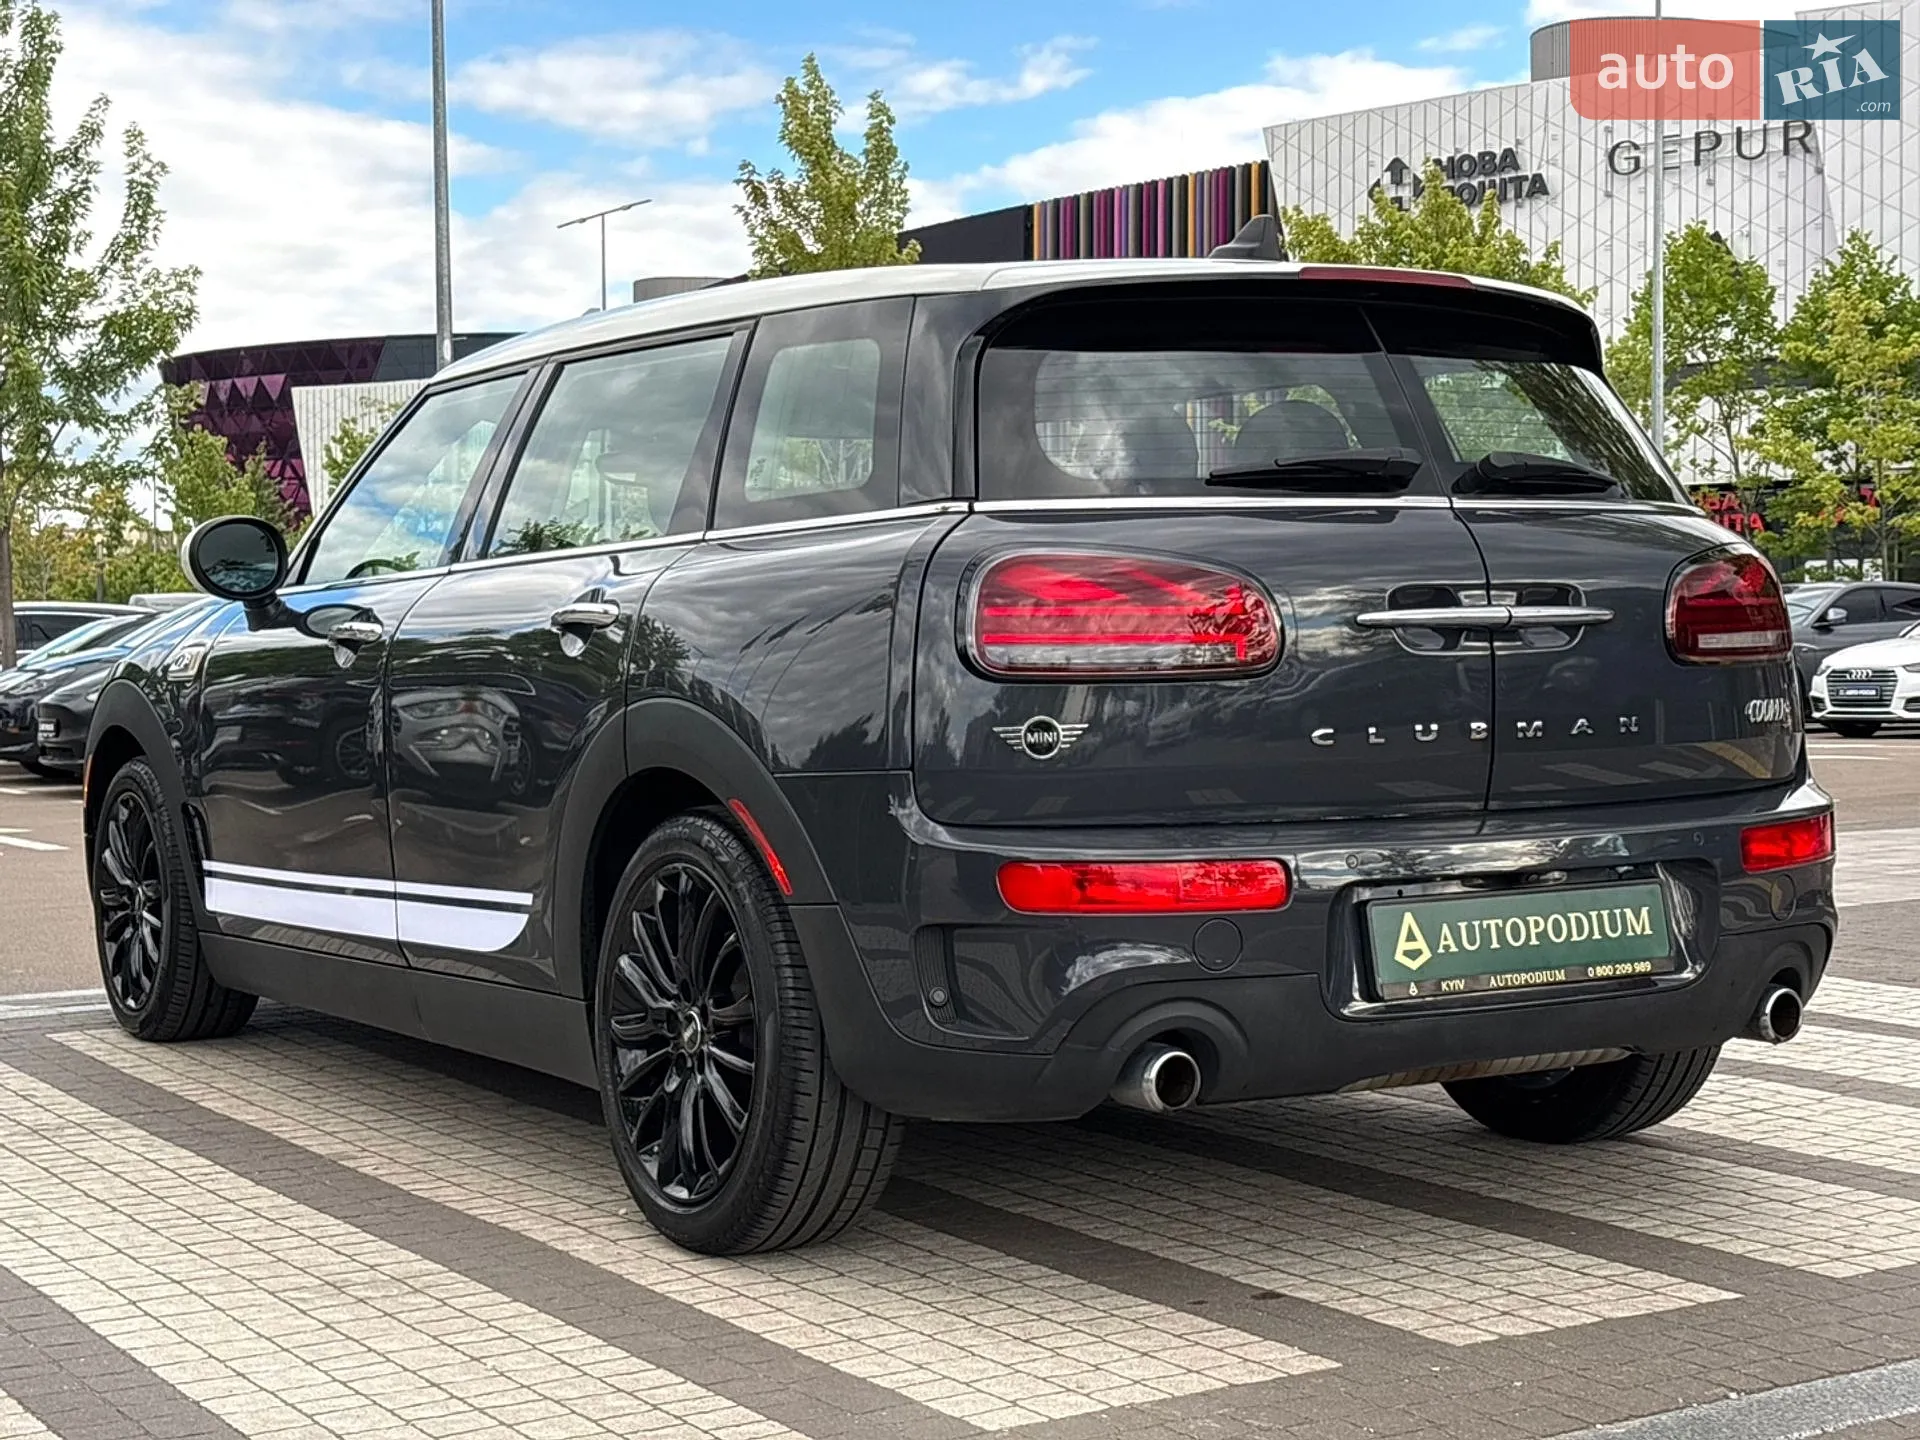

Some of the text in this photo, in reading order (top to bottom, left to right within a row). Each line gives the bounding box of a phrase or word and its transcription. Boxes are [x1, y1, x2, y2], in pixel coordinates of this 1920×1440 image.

[1026, 731, 1058, 744] MINI
[1437, 906, 1653, 953] AUTOPODIUM
[1441, 979, 1465, 992] KYIV
[1489, 969, 1566, 988] AUTOPODIUM
